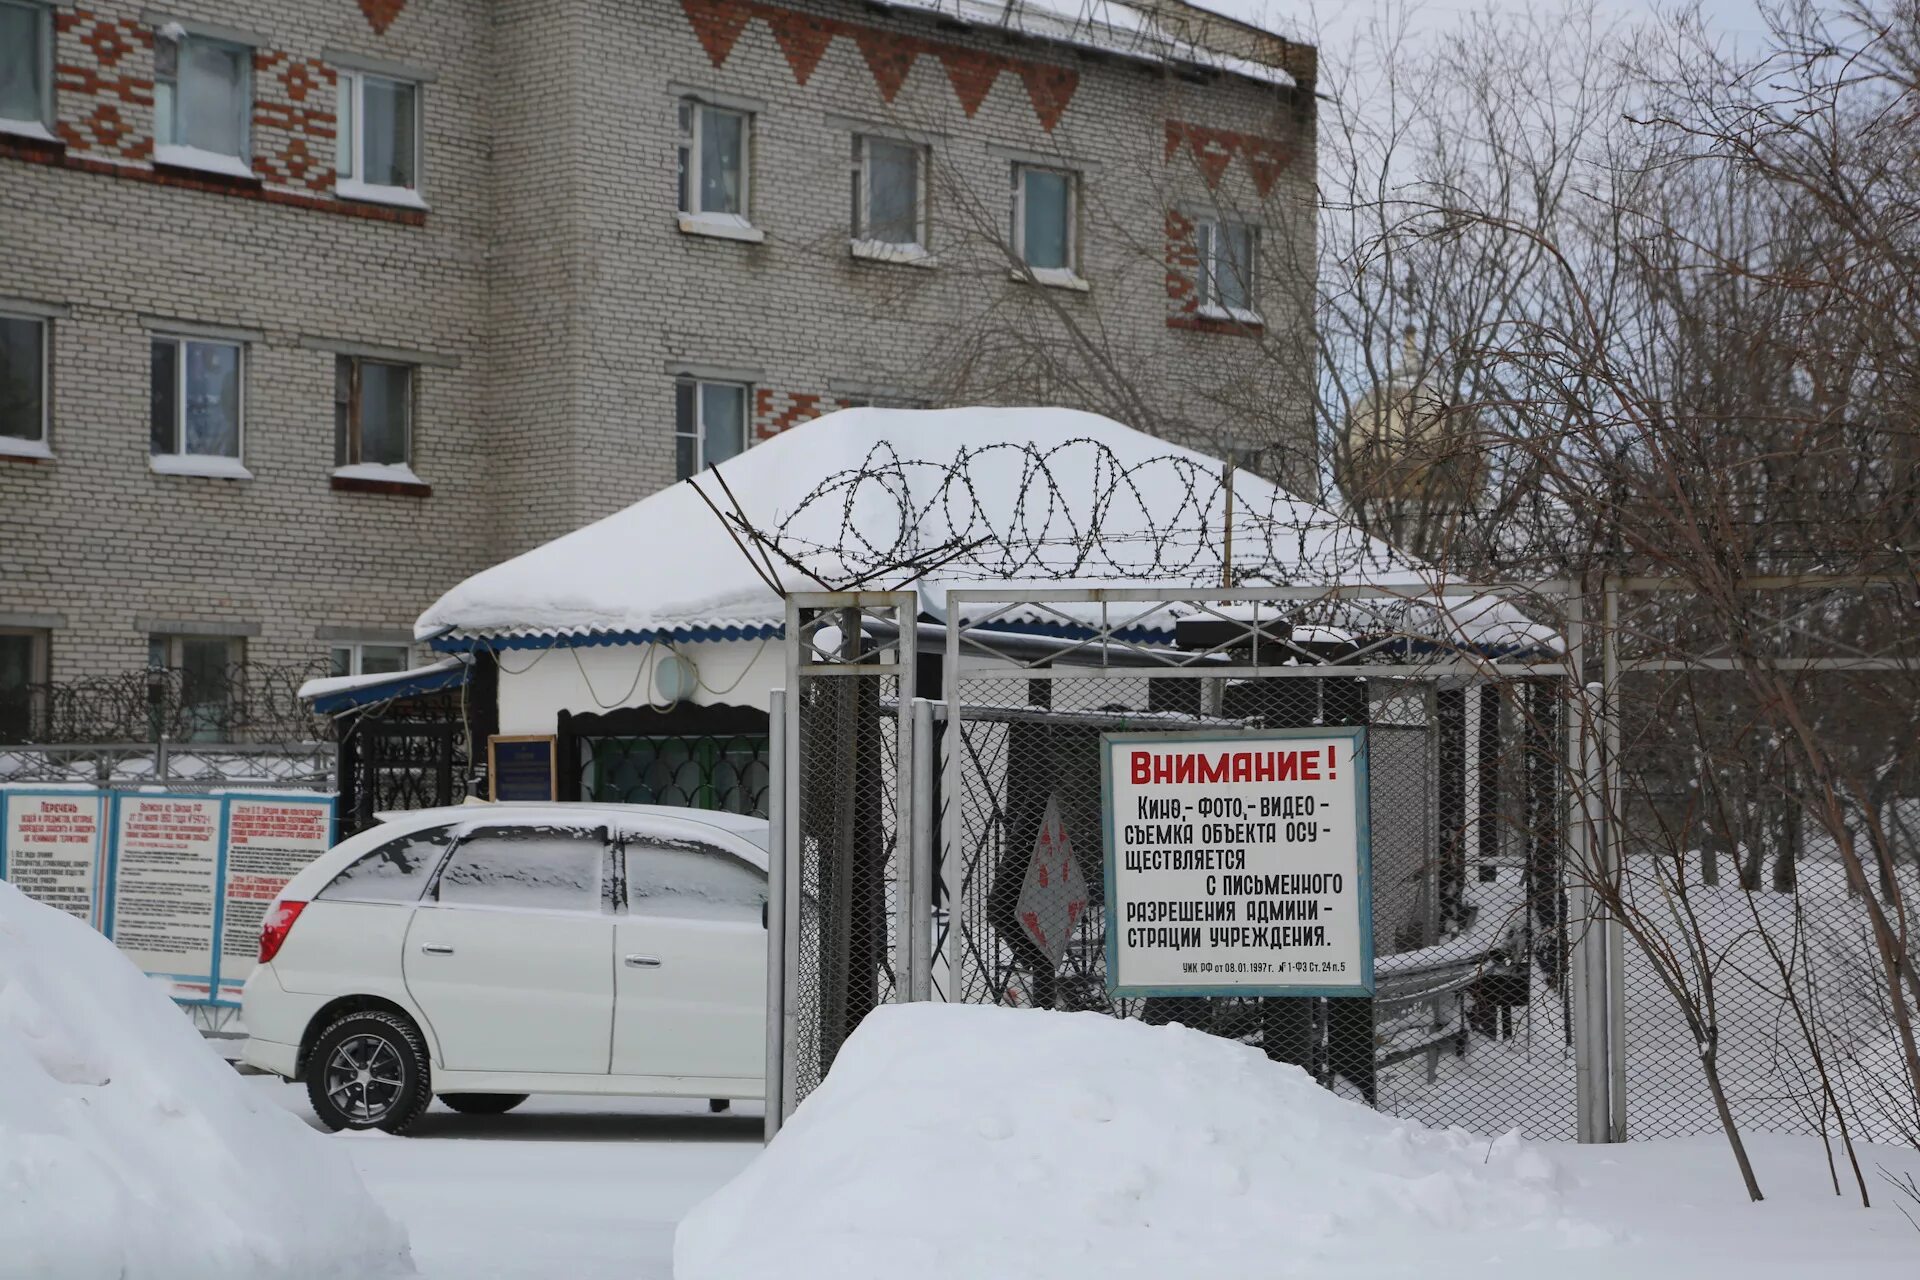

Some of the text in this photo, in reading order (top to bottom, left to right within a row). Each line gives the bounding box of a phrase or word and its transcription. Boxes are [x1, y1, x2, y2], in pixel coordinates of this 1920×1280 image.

[1130, 745, 1337, 785] ВНИМАНИЕ!
[1124, 824, 1193, 845] СЪЕМКА
[1201, 823, 1276, 844] ОБЪЕКТА
[1125, 848, 1245, 873] ЩЕСТВЛЯЕТСЯ
[1206, 873, 1343, 896] С ПИСЬМЕННОГО
[1126, 901, 1236, 923] РАЗРЕШЕНИЯ
[1127, 926, 1332, 952] СТРАЦИИ УЧРЕЖДЕНИЯ.
[1200, 962, 1213, 973] РФ
